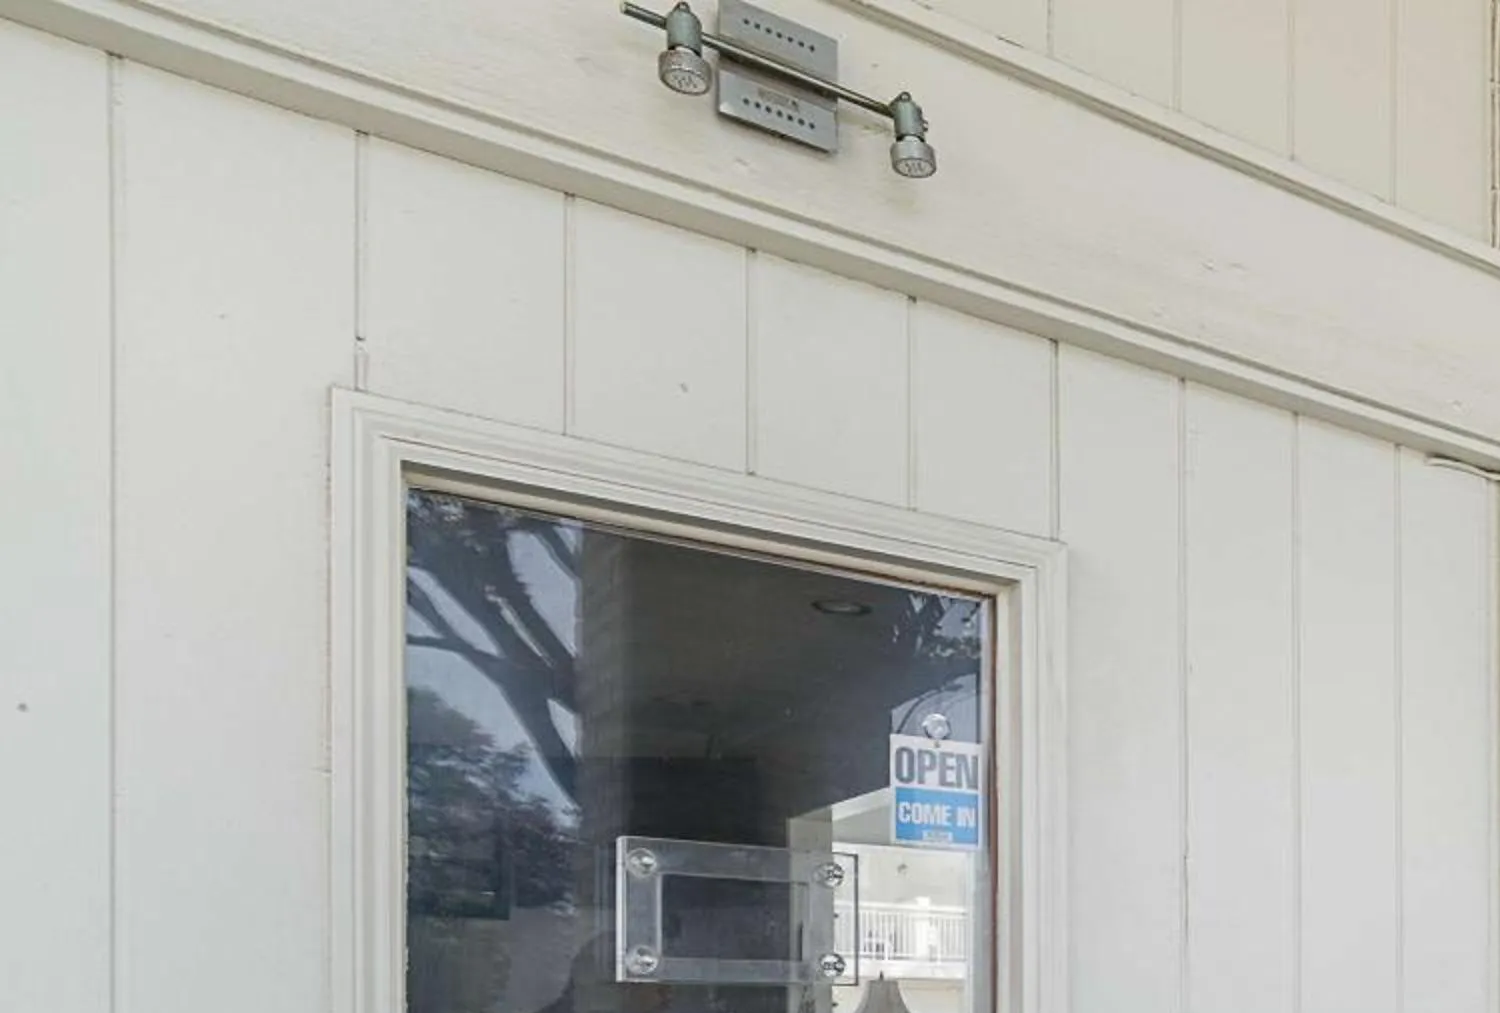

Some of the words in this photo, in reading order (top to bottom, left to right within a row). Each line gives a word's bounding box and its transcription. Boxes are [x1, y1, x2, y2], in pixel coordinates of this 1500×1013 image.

[895, 746, 979, 790] OPEN
[898, 800, 952, 826] COME
[957, 805, 976, 829] IN
